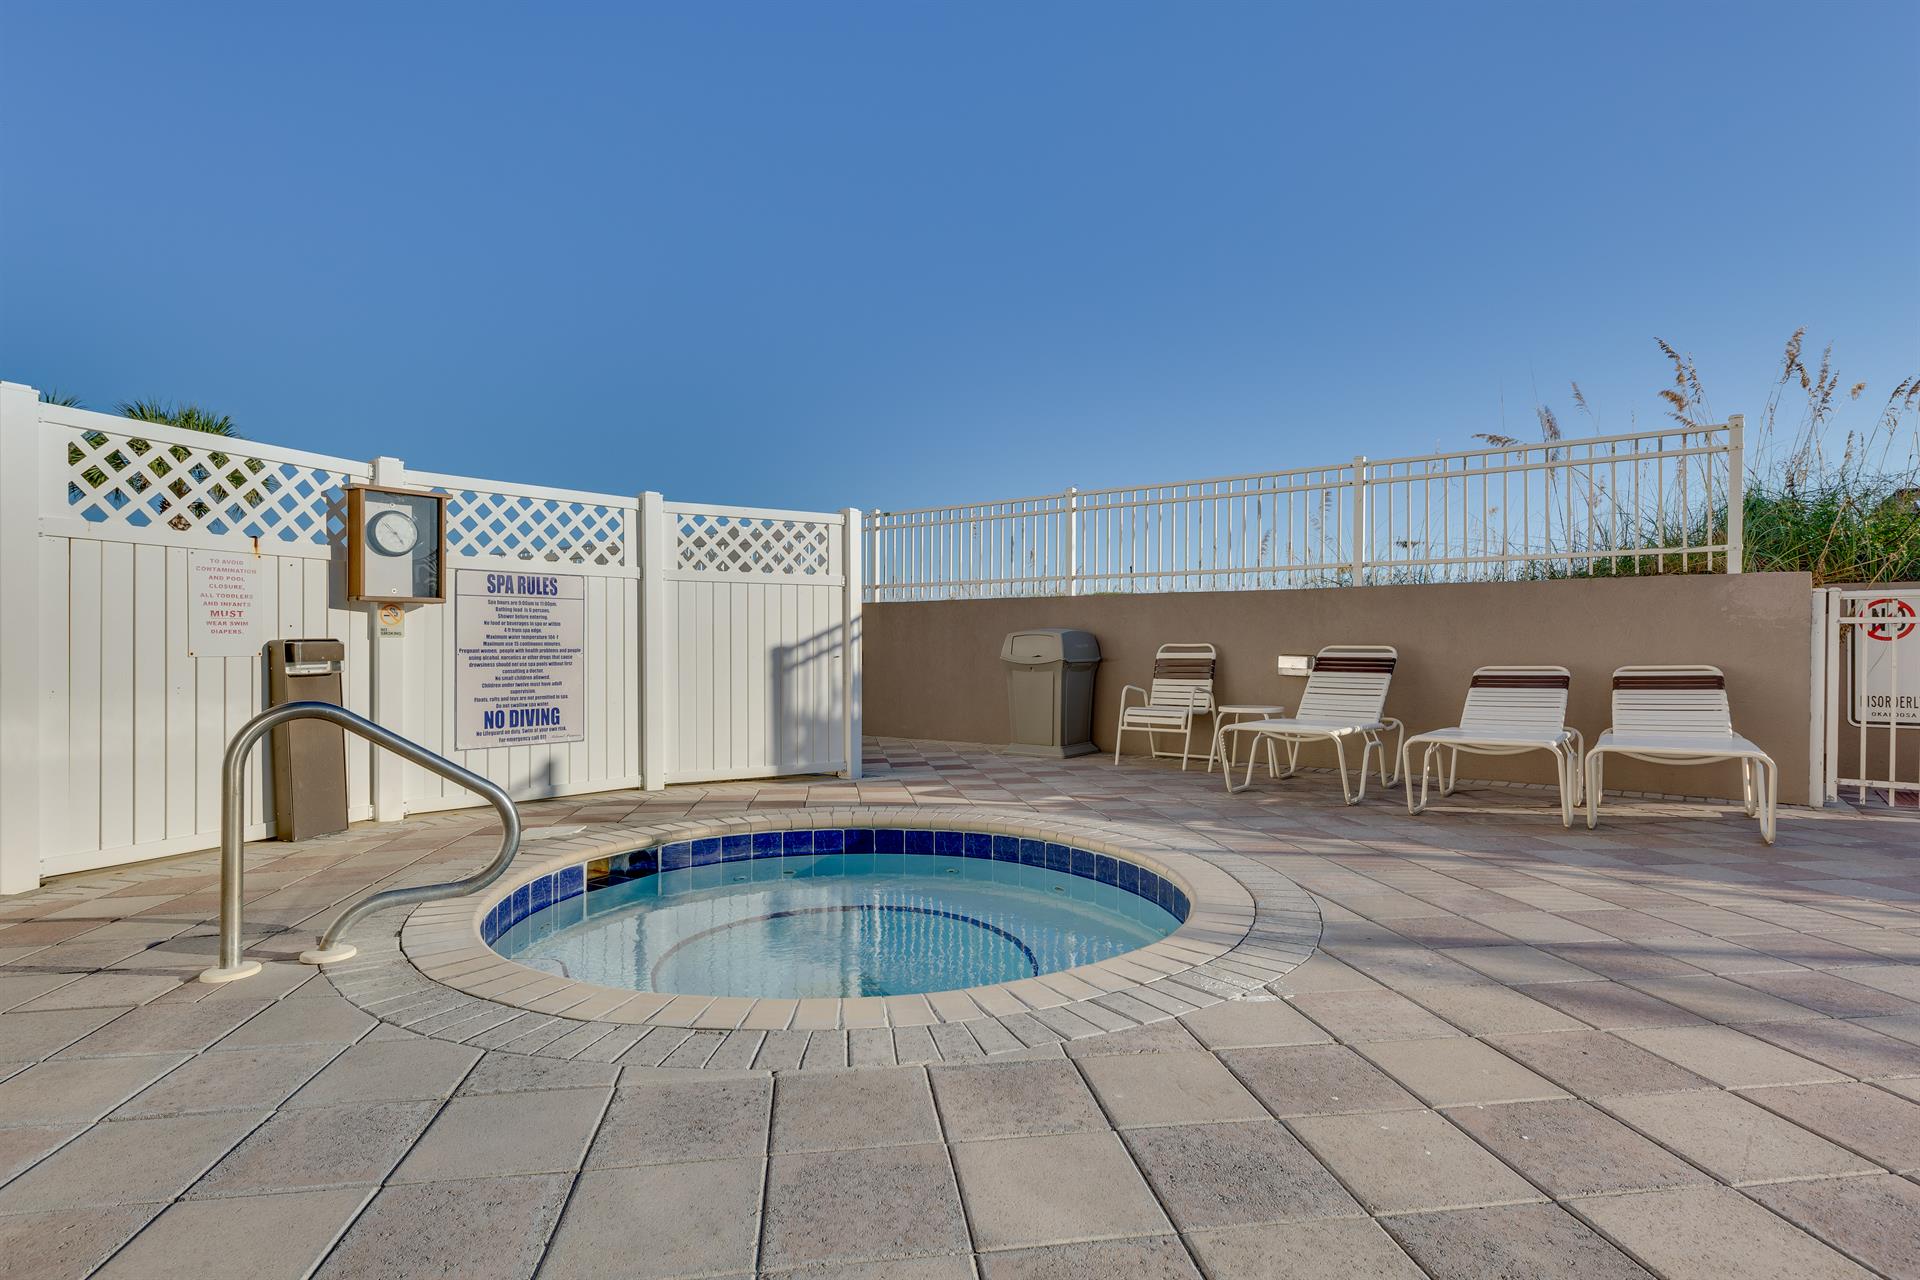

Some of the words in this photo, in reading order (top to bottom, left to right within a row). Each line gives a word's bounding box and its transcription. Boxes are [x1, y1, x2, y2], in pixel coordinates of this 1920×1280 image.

[195, 566, 257, 574] CONTAMINATION
[487, 573, 514, 594] SPA
[518, 575, 558, 596] RULES
[209, 610, 244, 618] MUST
[1860, 696, 1920, 708] ISORERL
[484, 710, 505, 730] NO
[510, 707, 560, 728] DIVING
